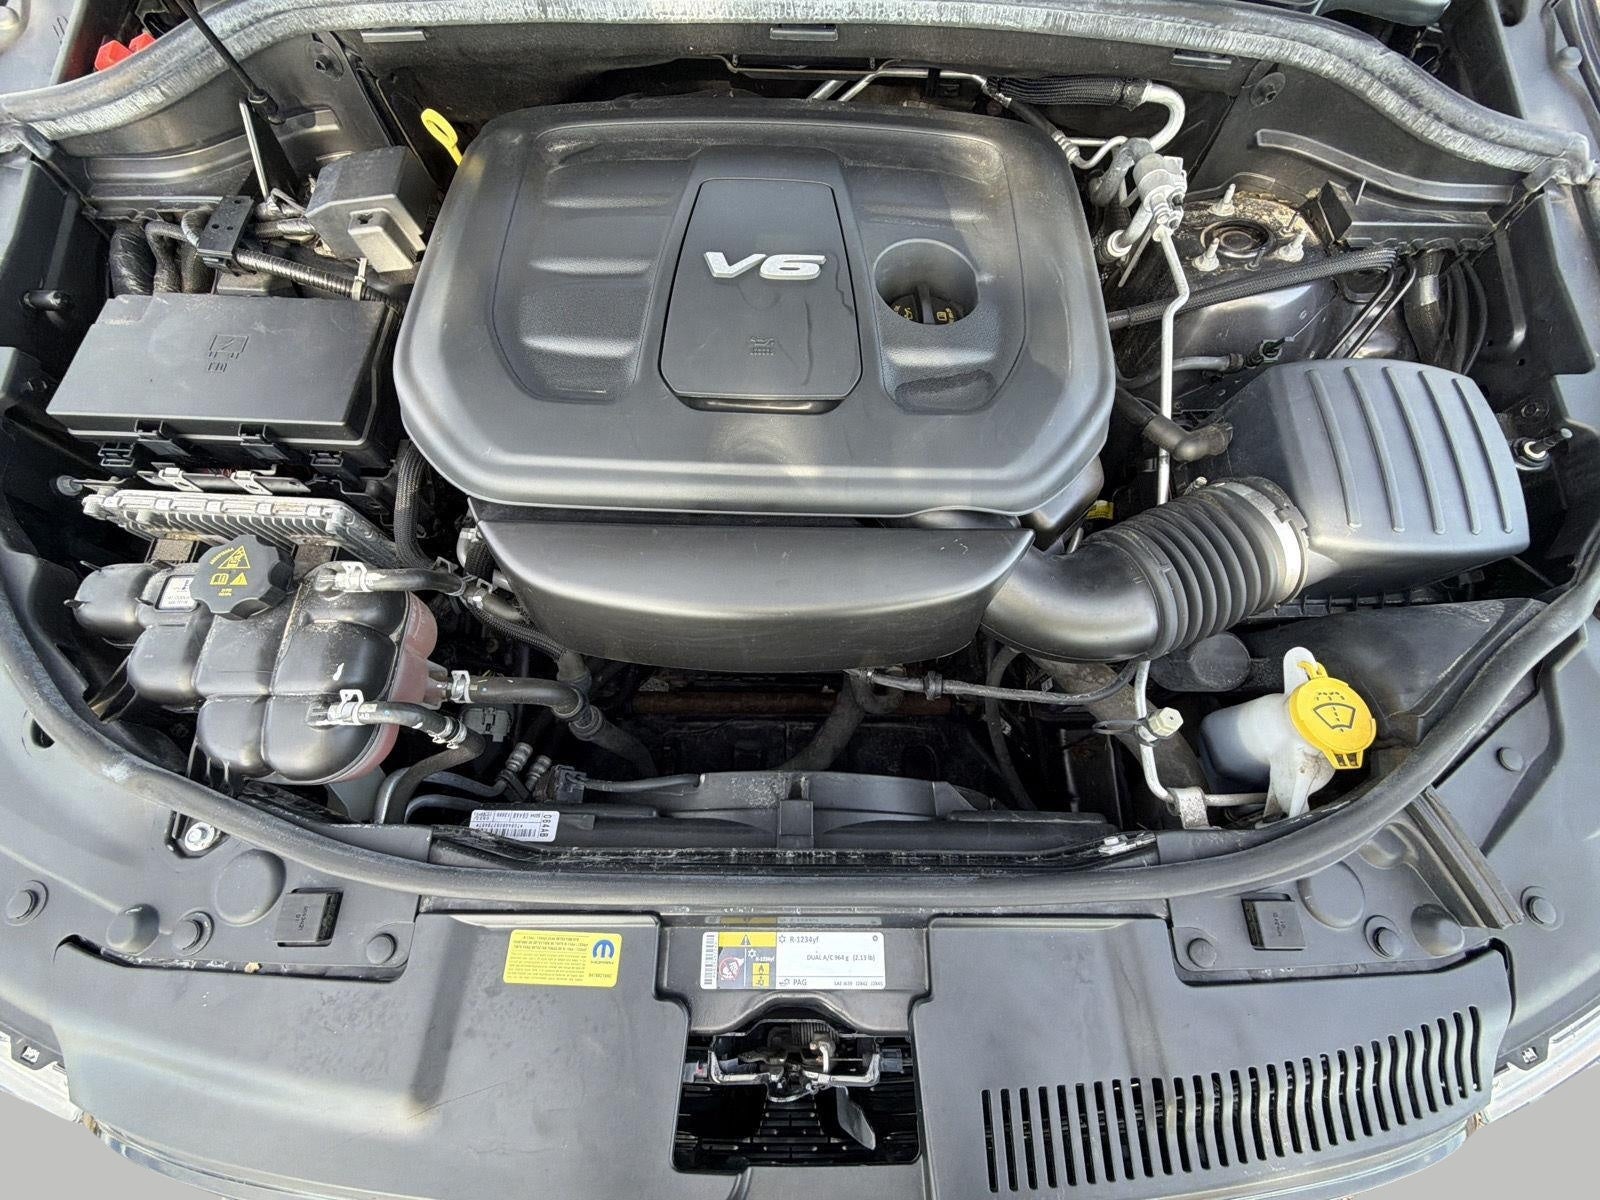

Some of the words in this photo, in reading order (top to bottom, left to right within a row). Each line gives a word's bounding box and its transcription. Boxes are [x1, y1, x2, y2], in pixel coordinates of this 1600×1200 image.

[704, 251, 827, 281] V6
[539, 814, 553, 838] 064AB
[789, 935, 820, 945] R-1234yf
[822, 954, 834, 963] A/C
[792, 978, 808, 987] PAG
